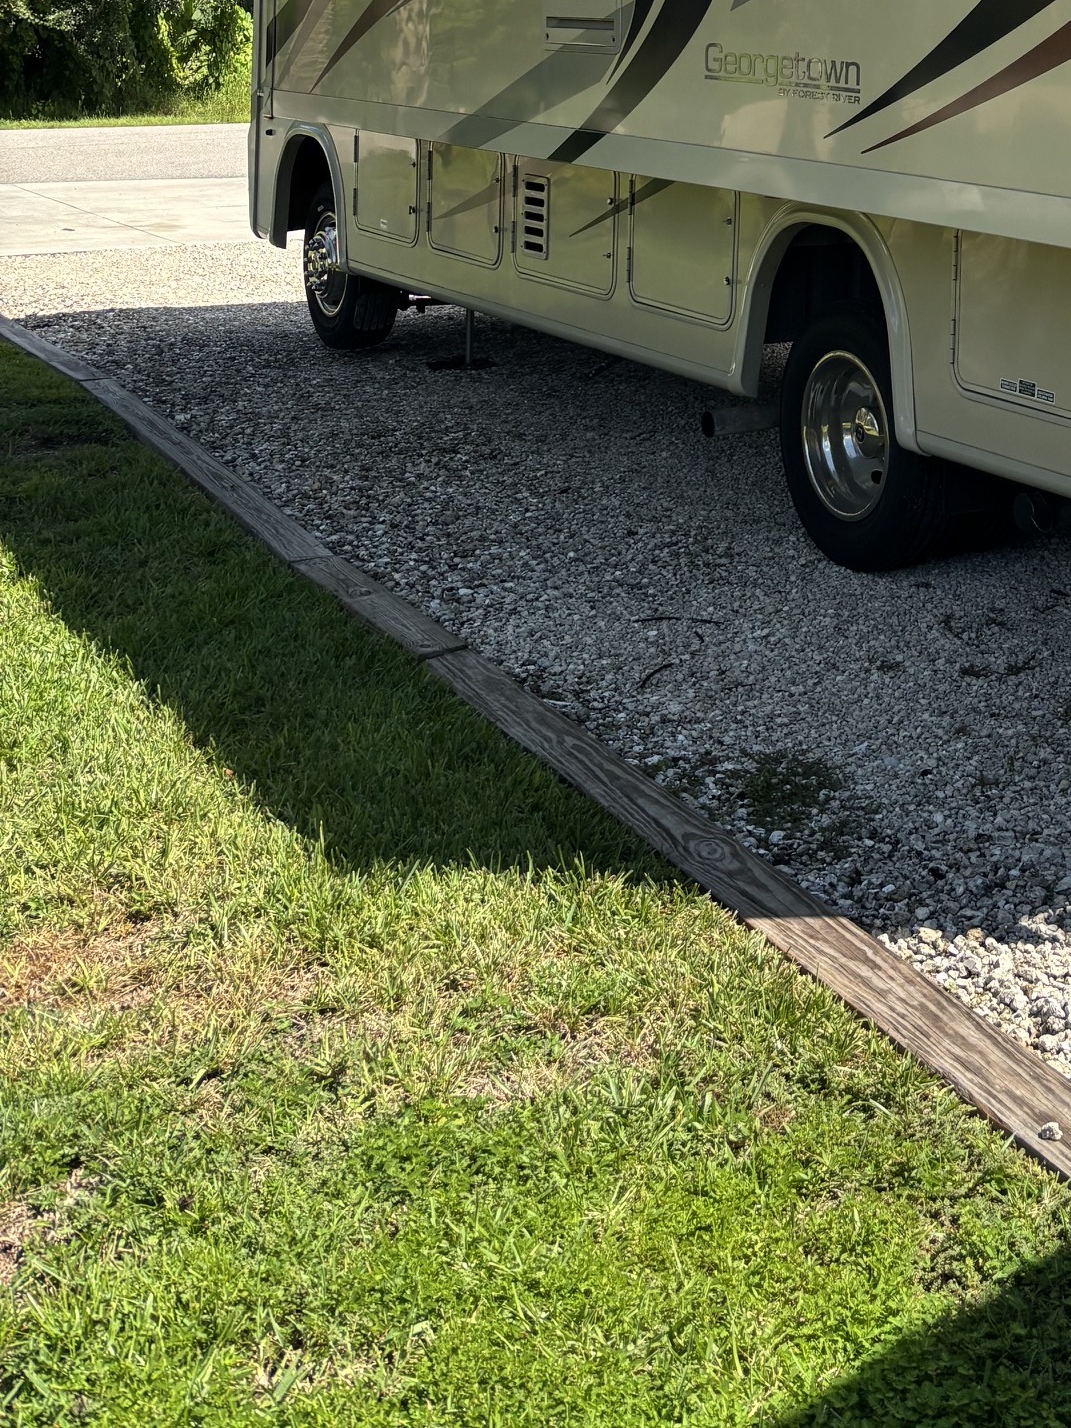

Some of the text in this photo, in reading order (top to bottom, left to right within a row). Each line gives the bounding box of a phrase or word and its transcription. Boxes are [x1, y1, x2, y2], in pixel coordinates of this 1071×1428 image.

[704, 42, 861, 87] Georgetown
[792, 88, 830, 101] FOREST
[832, 92, 861, 106] RIVER
